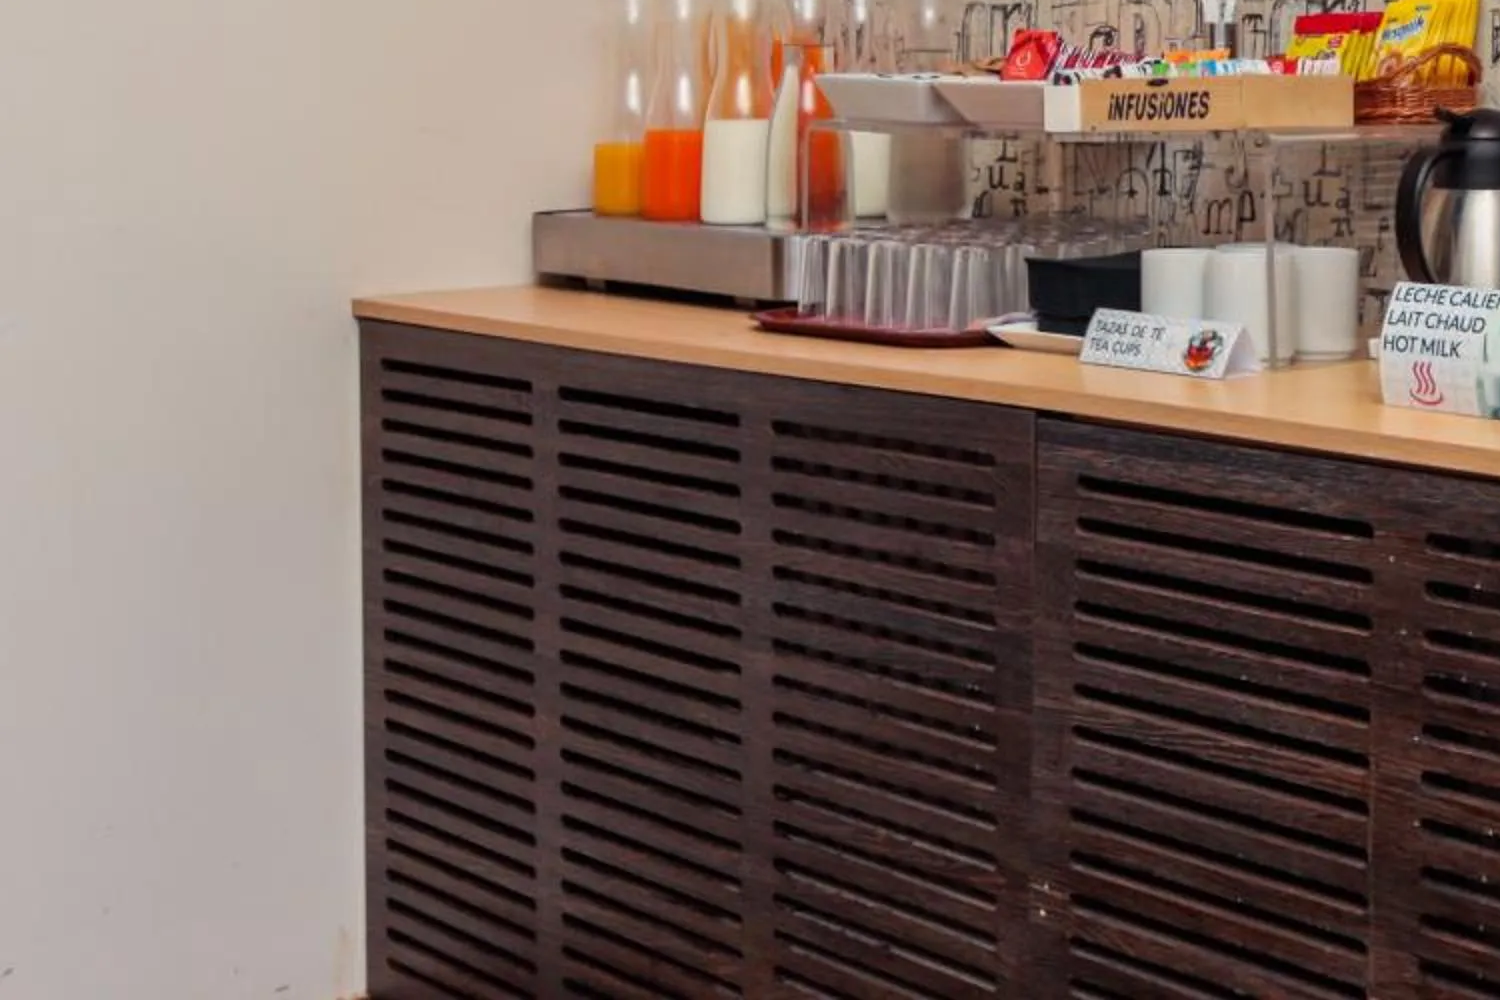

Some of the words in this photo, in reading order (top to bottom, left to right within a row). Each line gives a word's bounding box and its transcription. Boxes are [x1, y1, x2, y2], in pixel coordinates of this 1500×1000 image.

[1395, 287, 1448, 305] LECHE
[1388, 310, 1424, 327] LAIT
[1425, 313, 1487, 334] CHAUD
[1090, 337, 1109, 352] TEA
[1111, 340, 1143, 357] CUPS
[1383, 334, 1418, 352] HOT
[1420, 336, 1463, 358] MILK
